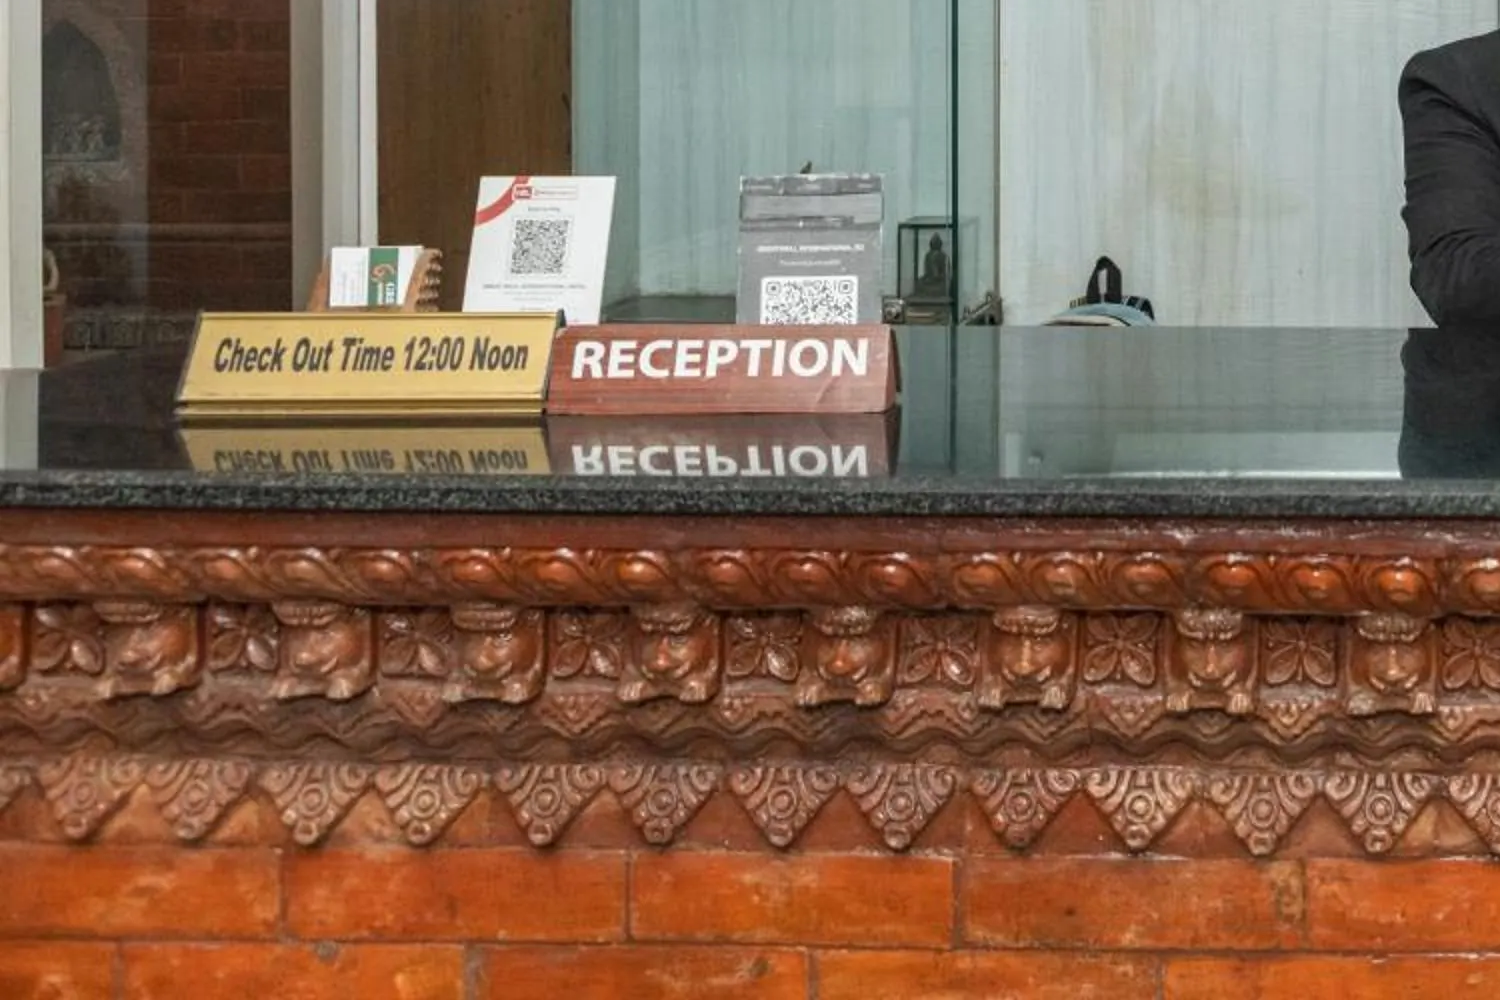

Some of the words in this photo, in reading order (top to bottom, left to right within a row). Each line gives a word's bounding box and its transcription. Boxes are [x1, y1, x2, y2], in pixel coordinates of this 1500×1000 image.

[213, 336, 287, 373] Check
[291, 336, 334, 372] Out
[340, 336, 395, 372] Time
[403, 335, 465, 372] 12:00
[468, 335, 529, 371] Noon
[571, 337, 869, 379] RECEPTION
